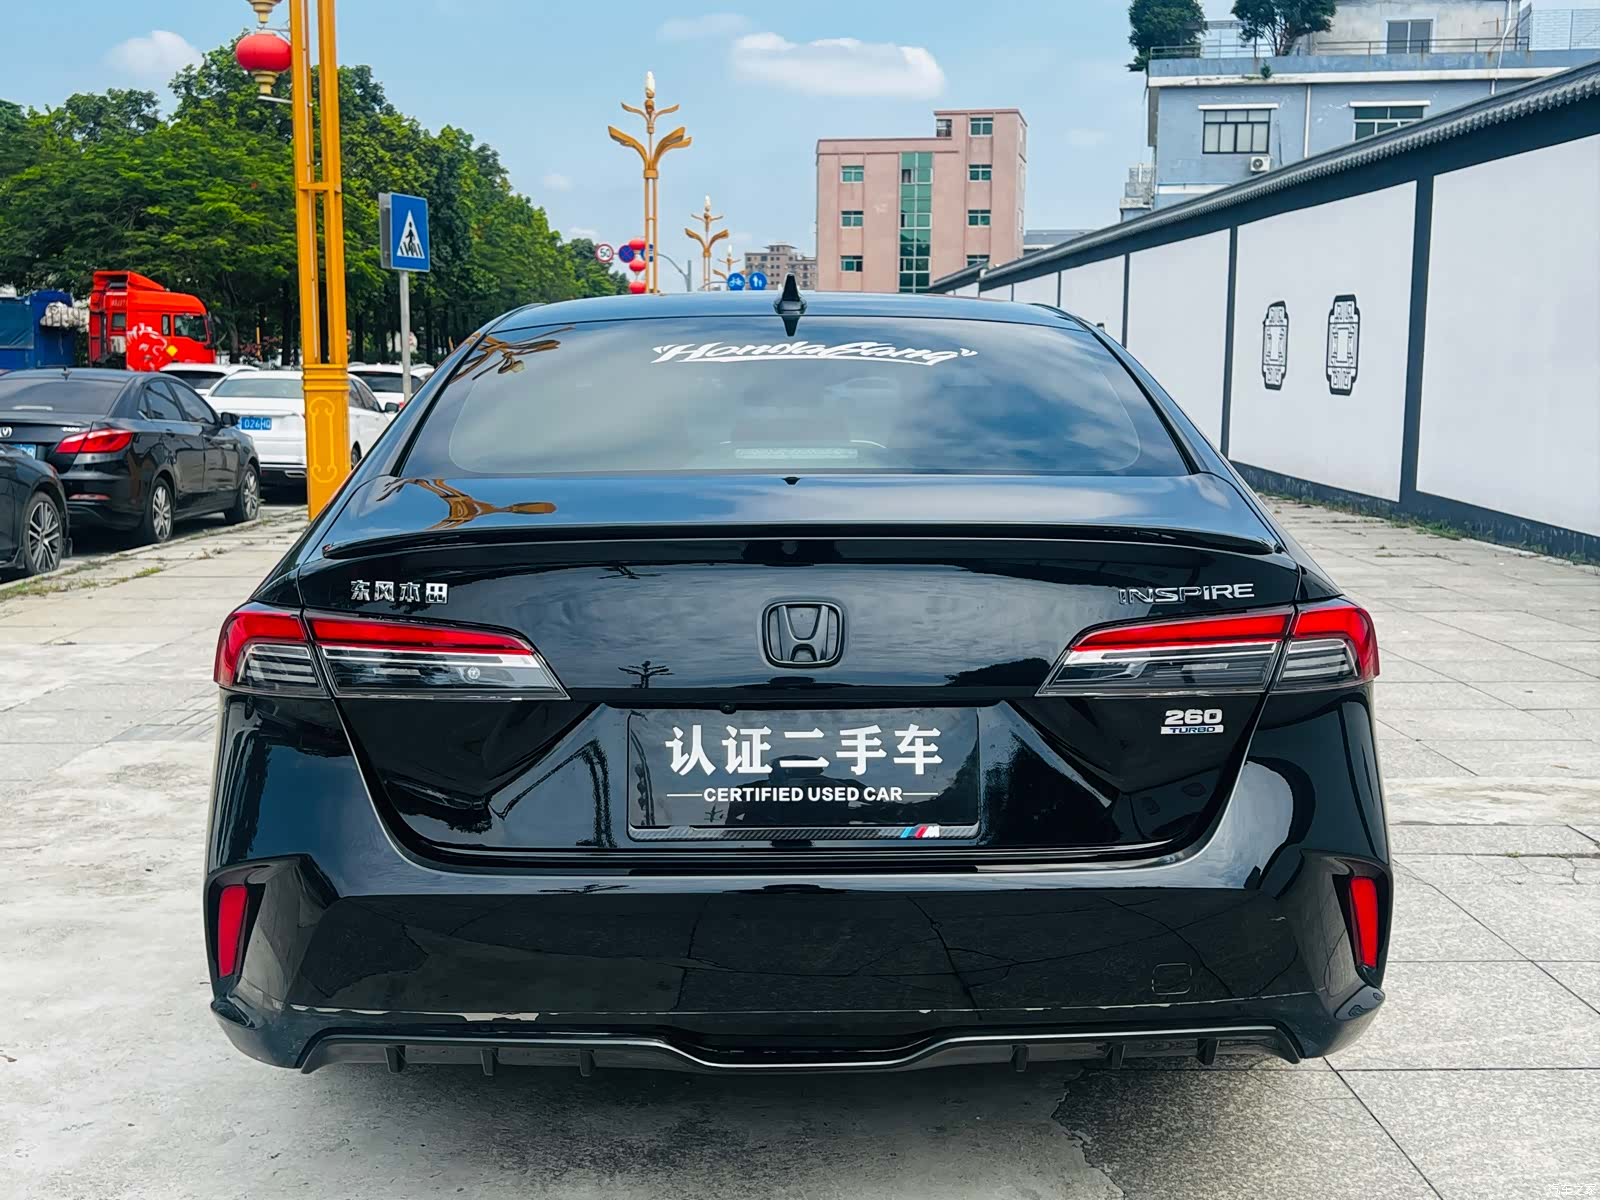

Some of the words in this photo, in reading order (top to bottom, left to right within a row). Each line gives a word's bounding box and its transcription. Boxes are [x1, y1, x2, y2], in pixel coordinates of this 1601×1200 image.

[600, 248, 610, 258] 50
[350, 580, 448, 603] 东风本田
[1118, 583, 1255, 604] INSPIRE
[1164, 708, 1223, 725] 260
[1169, 726, 1216, 734] TURBO
[664, 724, 943, 776] 认证二手车
[703, 787, 804, 802] CERTIFIED
[807, 787, 860, 802] USED
[863, 787, 903, 802] CAR
